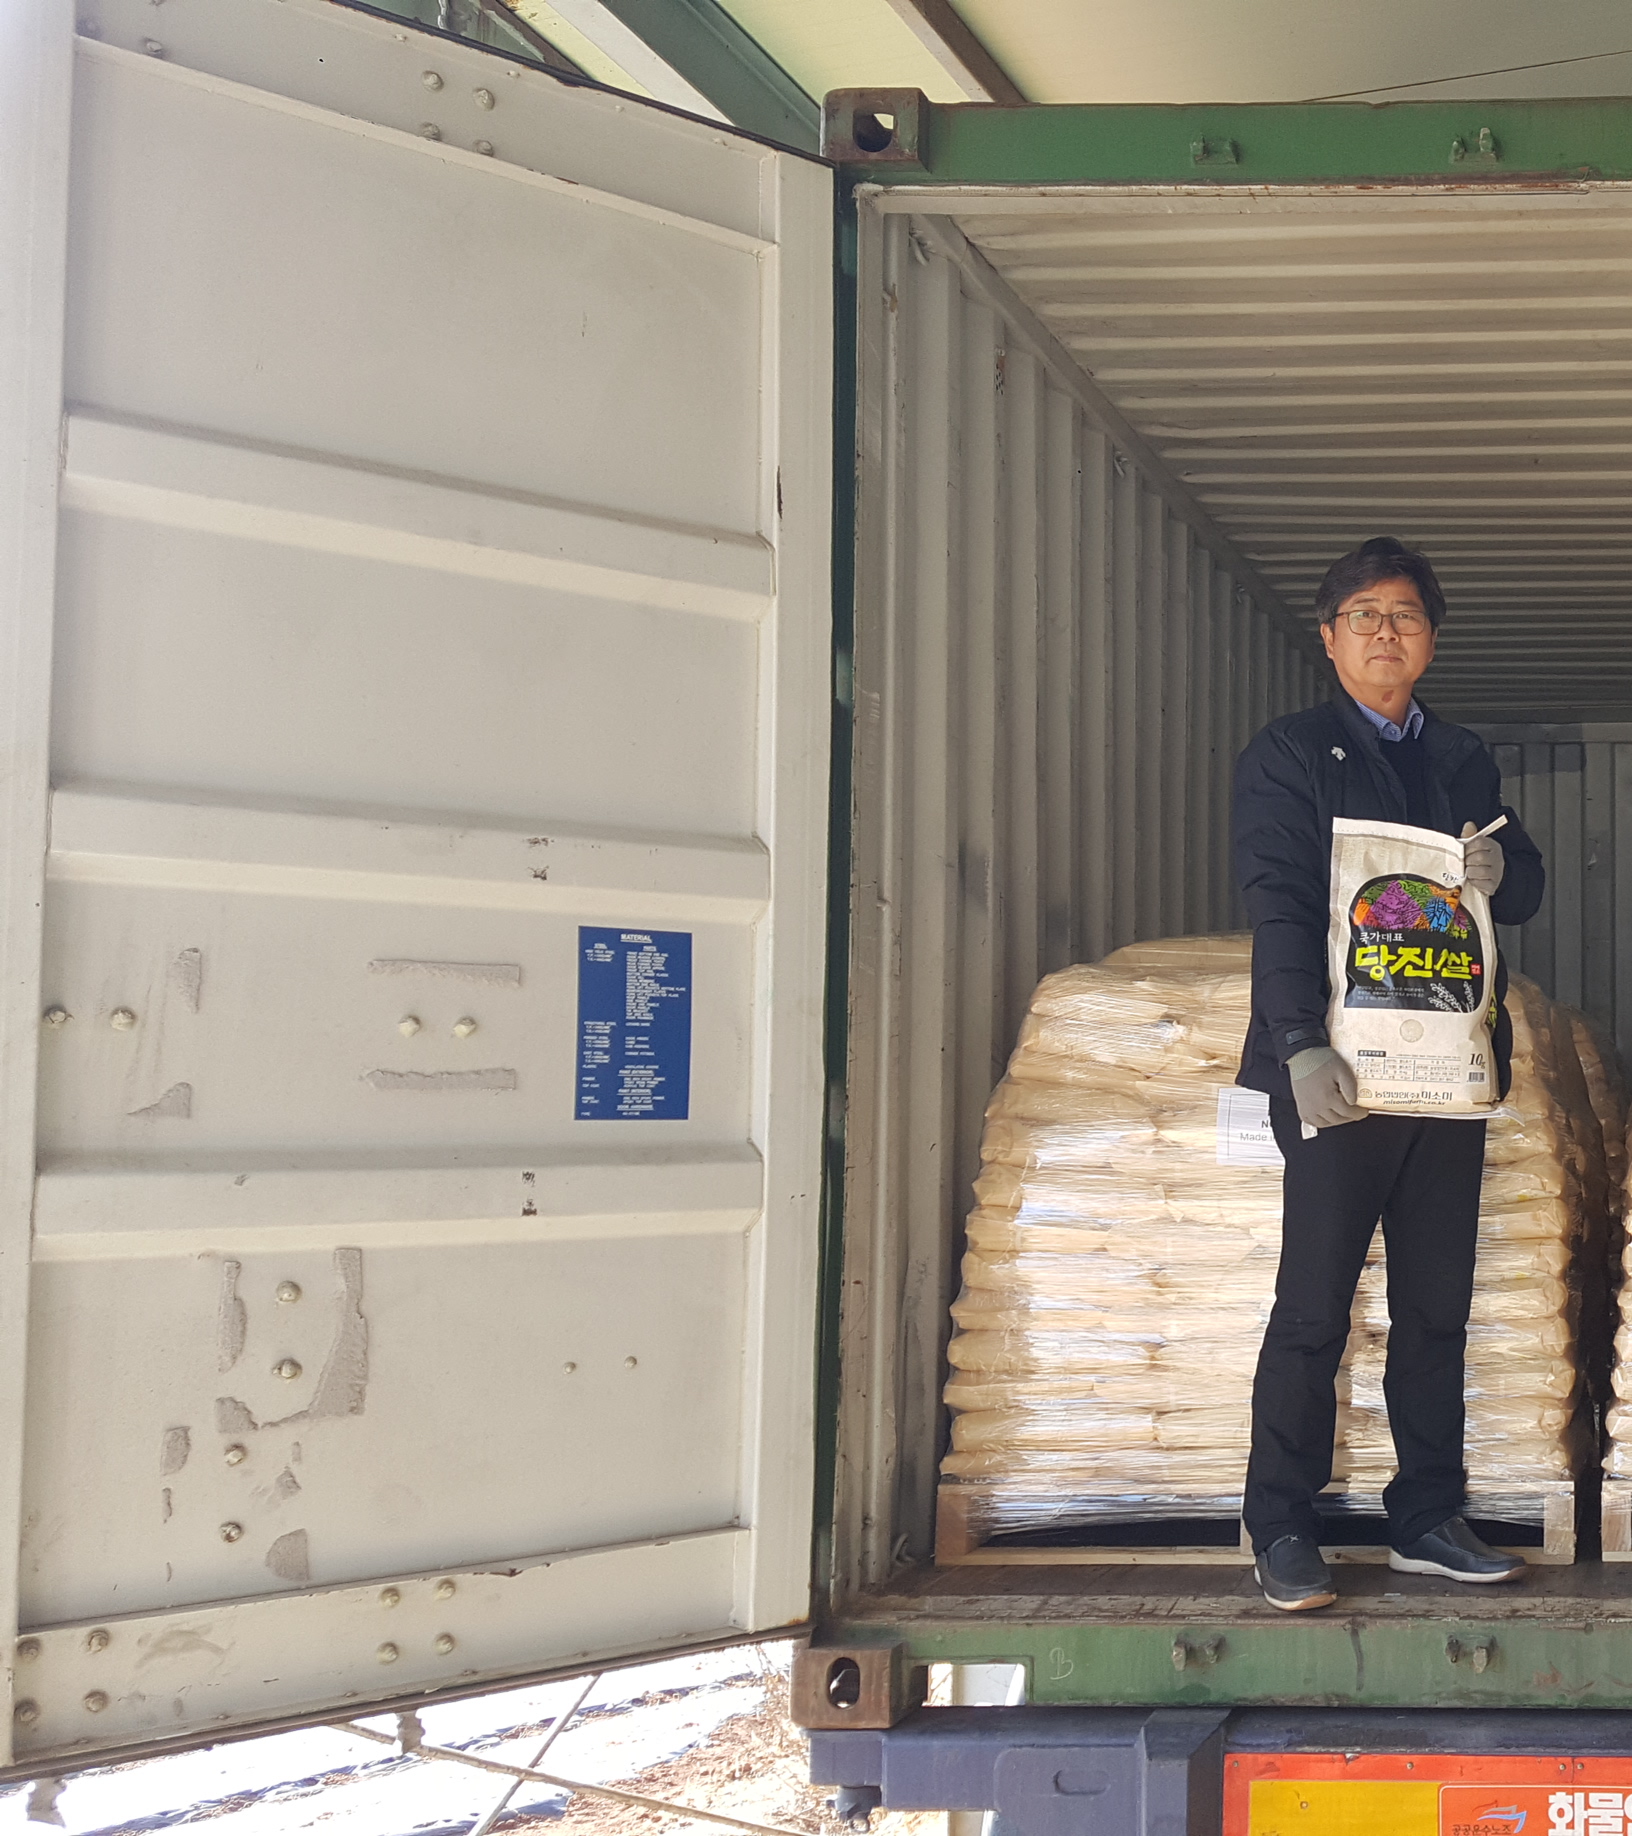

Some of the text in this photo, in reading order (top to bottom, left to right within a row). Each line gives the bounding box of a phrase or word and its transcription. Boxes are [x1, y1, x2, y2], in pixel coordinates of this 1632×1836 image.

[1355, 944, 1473, 981] 당진쌀
[1421, 1091, 1453, 1101] 미소미
[1240, 1133, 1267, 1141] Made
[1452, 1824, 1512, 1836] 공공운수노조
